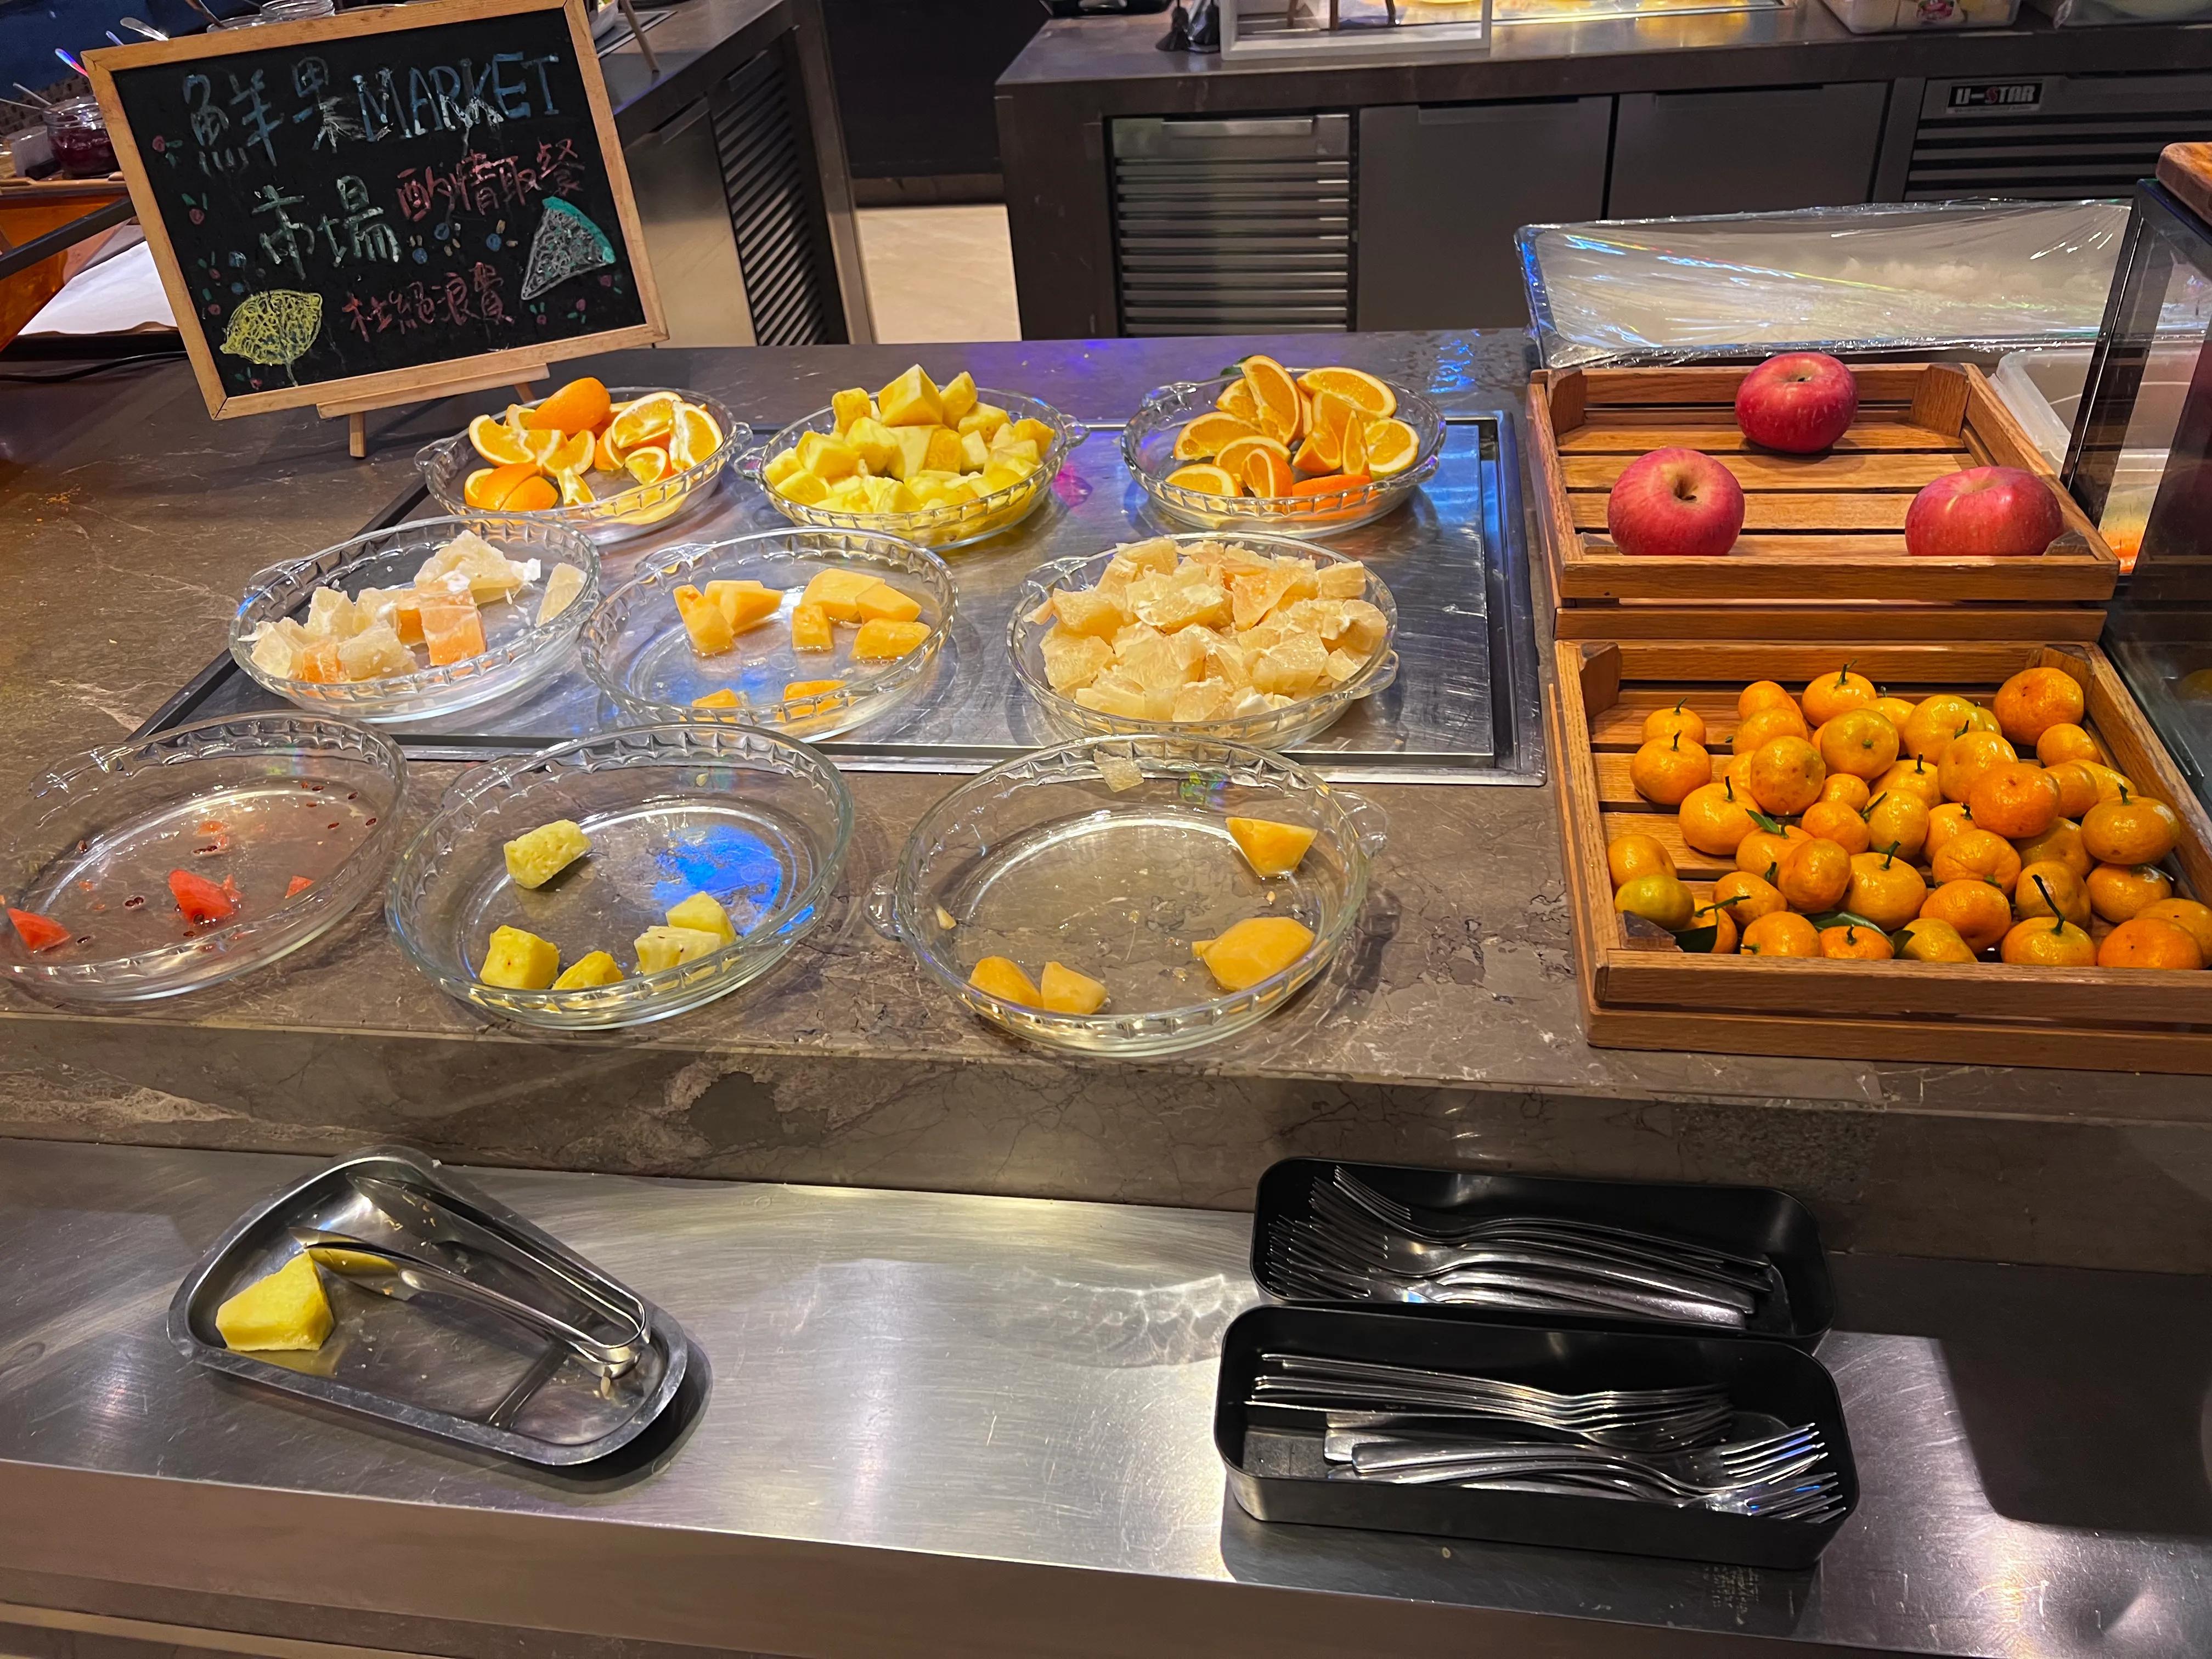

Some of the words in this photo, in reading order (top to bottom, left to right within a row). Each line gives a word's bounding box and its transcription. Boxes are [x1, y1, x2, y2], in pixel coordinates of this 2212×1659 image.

[351, 52, 560, 143] MARKET
[1955, 85, 2036, 105] U-STAR
[251, 174, 402, 281] 市場
